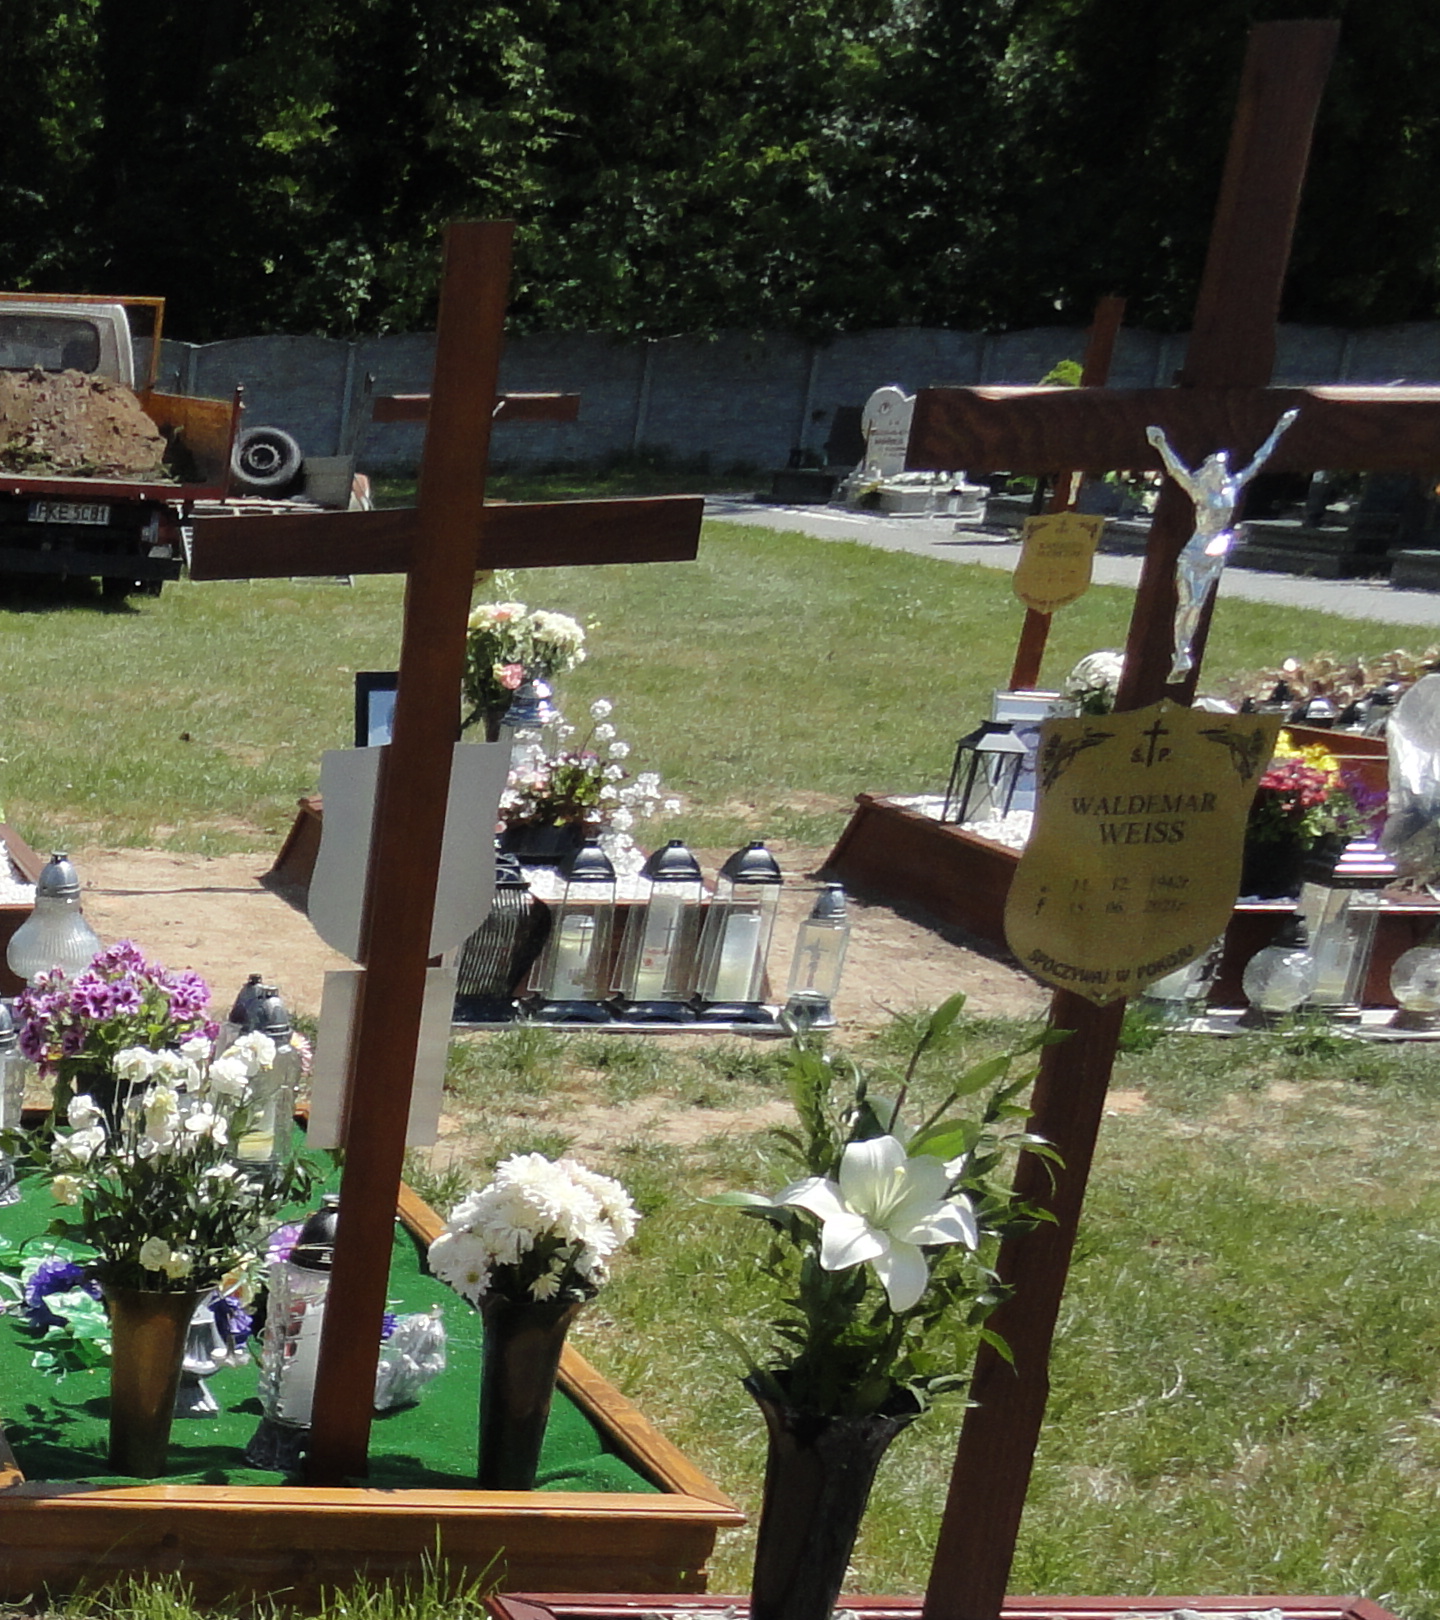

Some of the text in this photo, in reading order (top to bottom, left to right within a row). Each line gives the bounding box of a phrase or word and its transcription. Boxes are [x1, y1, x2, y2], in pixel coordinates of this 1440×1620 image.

[1071, 793, 1218, 816] WALDEMAR
[1100, 821, 1186, 846] WEISS
[1116, 969, 1131, 982] W
